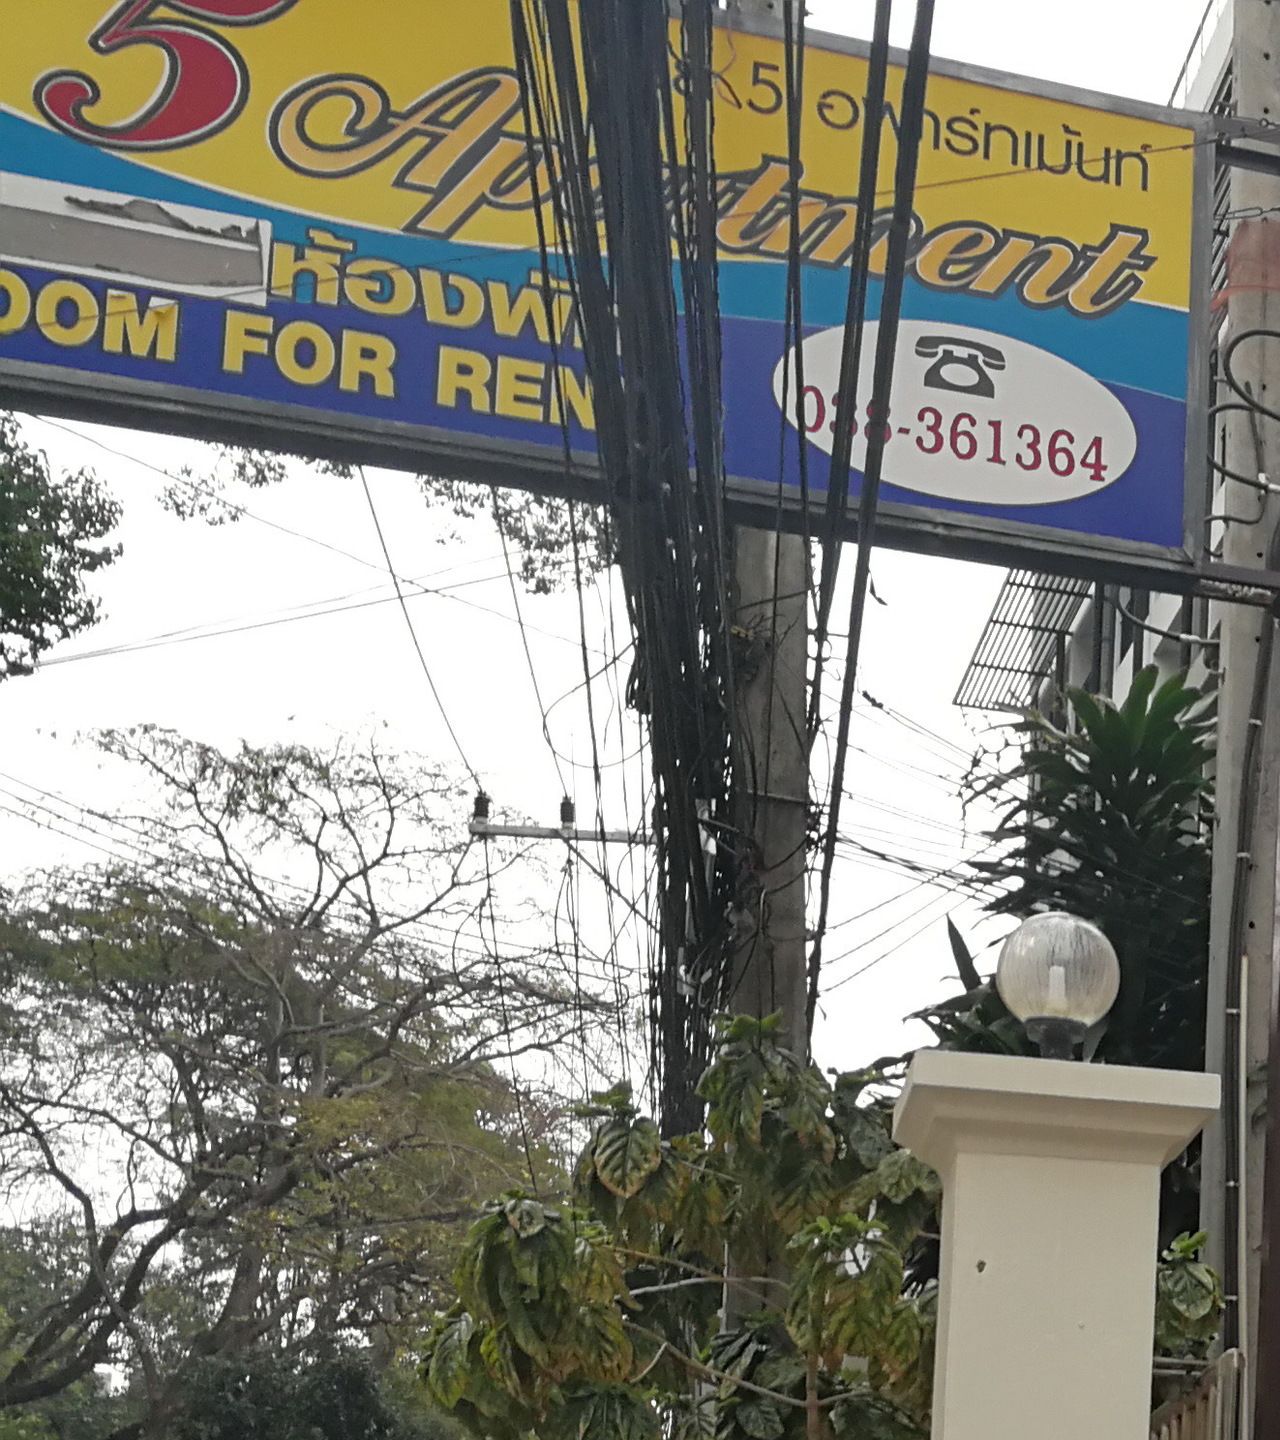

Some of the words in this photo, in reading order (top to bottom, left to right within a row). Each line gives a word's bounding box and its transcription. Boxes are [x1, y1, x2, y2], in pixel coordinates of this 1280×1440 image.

[33, 0, 300, 151] 5
[269, 66, 1158, 319] Aptment
[271, 228, 583, 350] ห้องพั
[221, 309, 397, 398] FOR
[436, 345, 597, 432] REN
